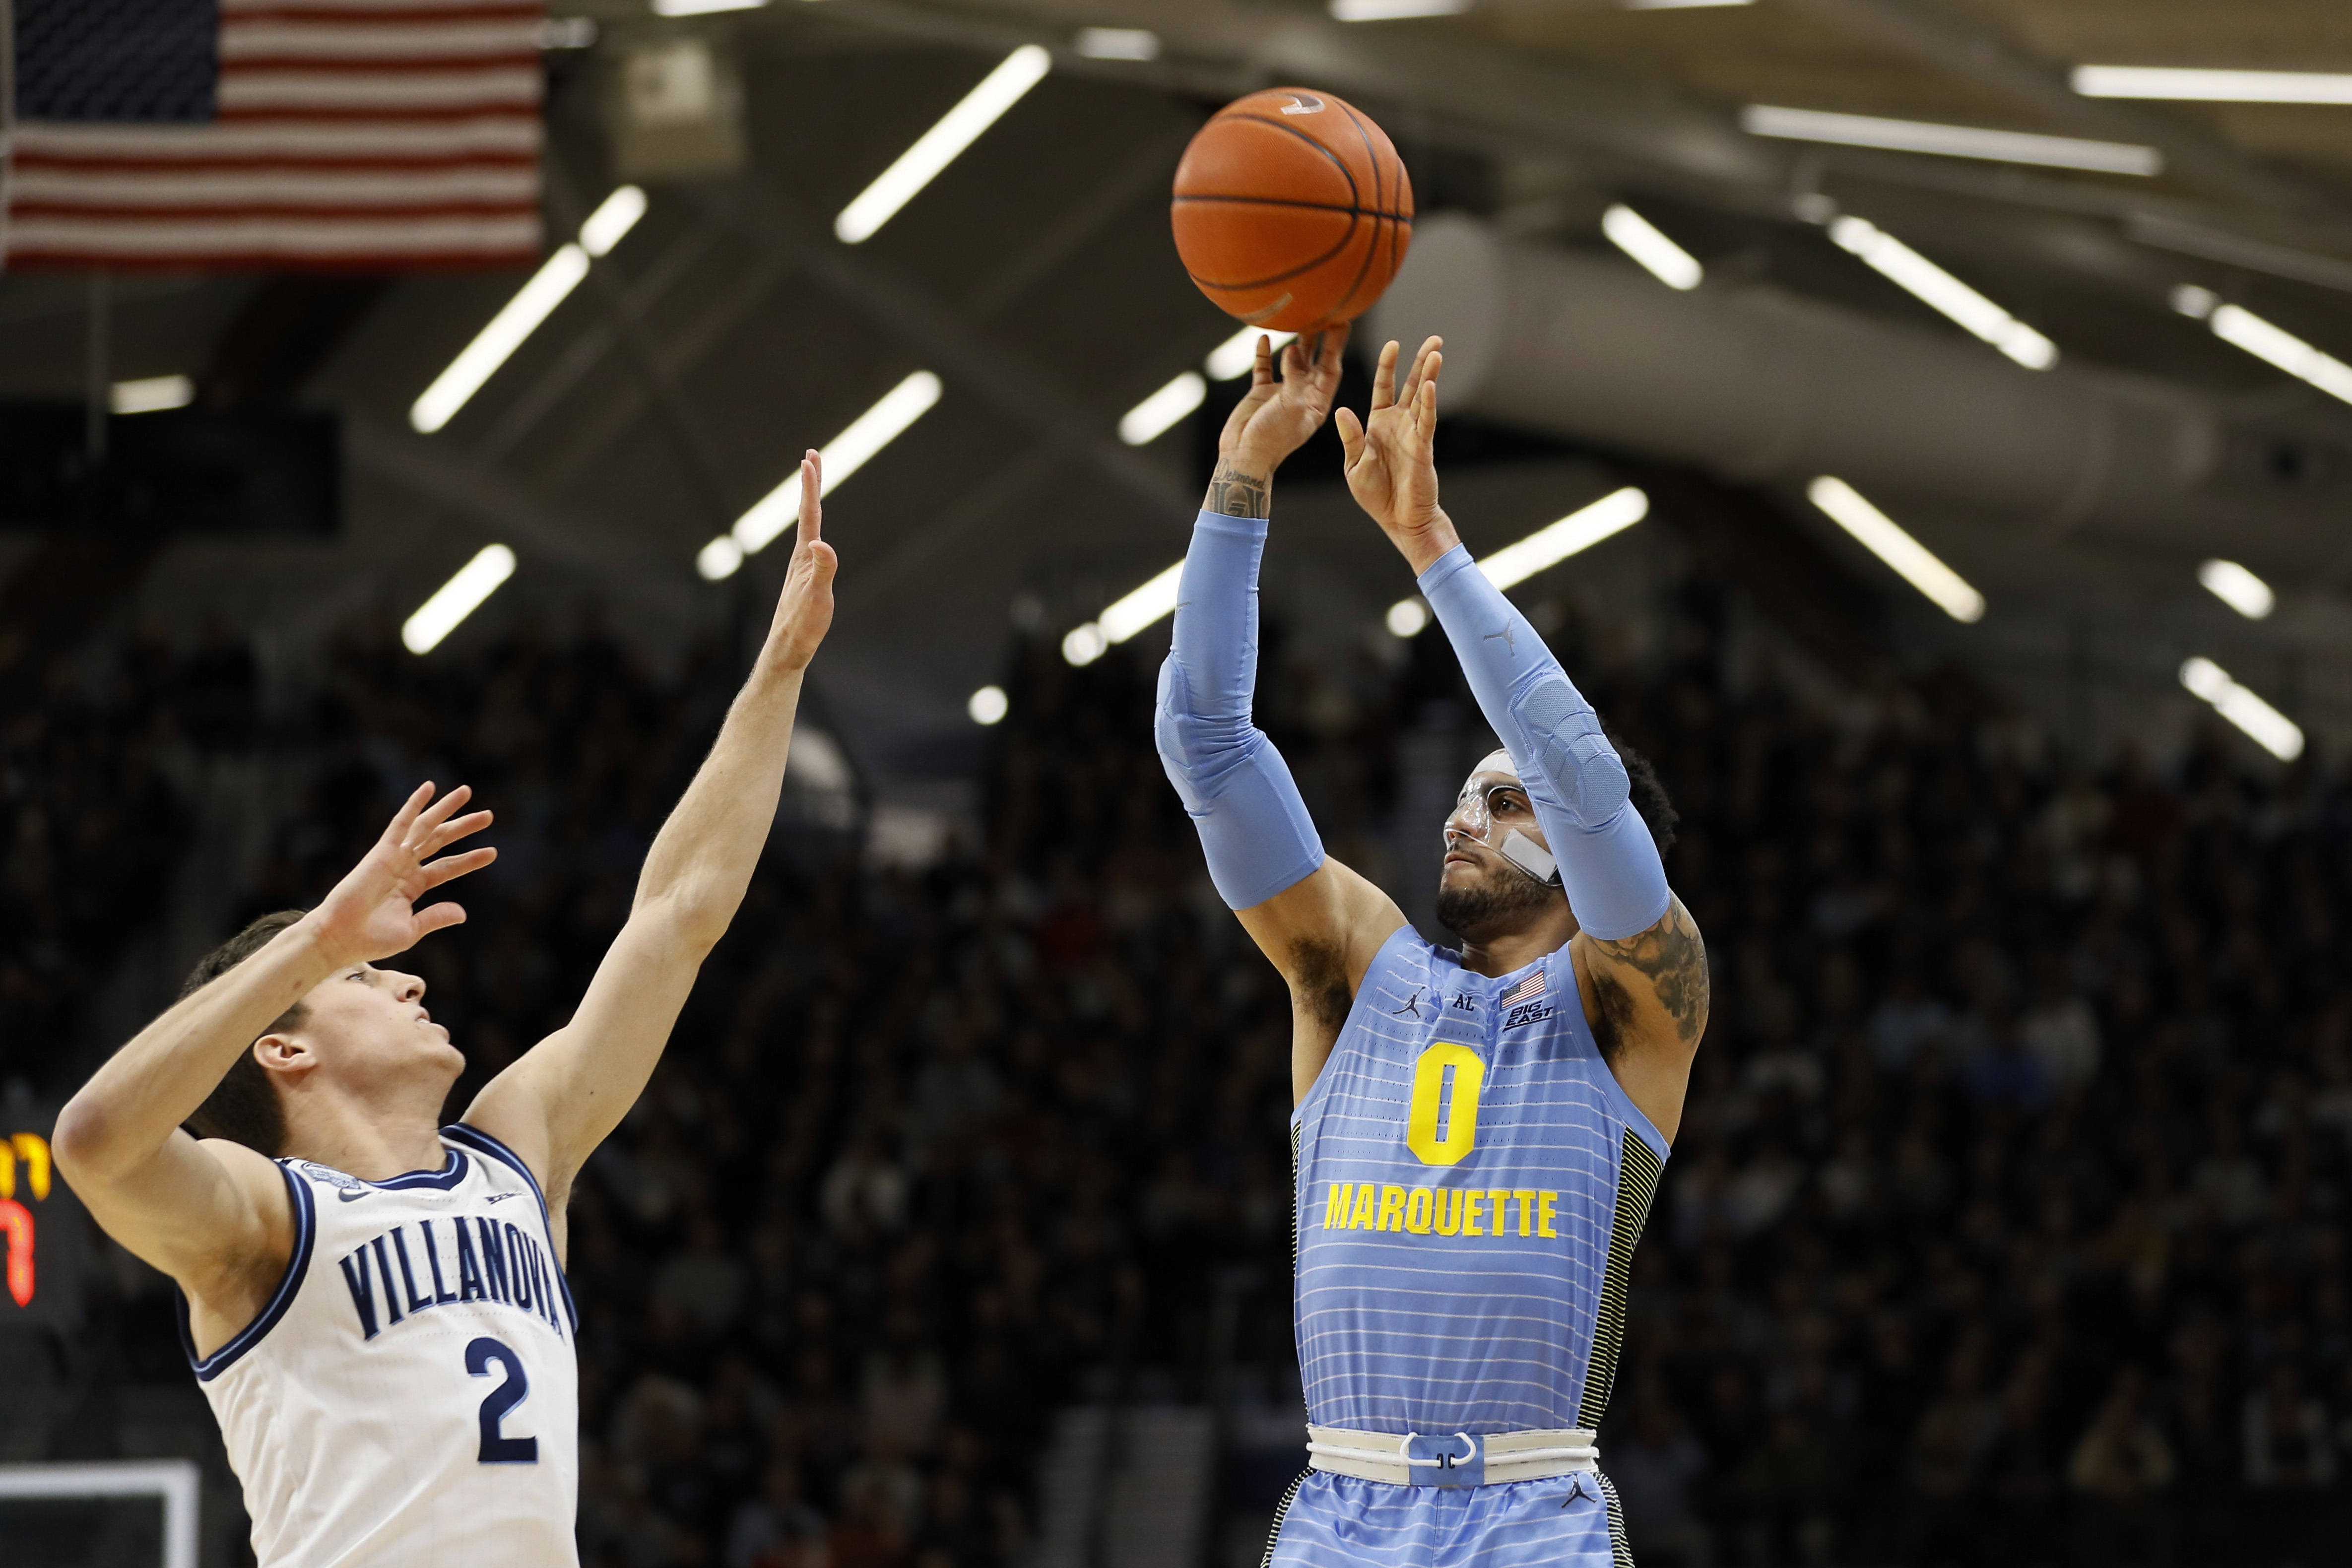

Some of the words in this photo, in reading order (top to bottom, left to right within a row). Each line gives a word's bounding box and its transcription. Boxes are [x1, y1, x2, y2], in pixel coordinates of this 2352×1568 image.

[1452, 994, 1474, 1012] AL
[1505, 1007, 1554, 1027] EAST
[1509, 1000, 1543, 1018] BIG
[1406, 1042, 1486, 1166] 0
[1323, 1183, 1558, 1239] MARQUETTE
[465, 1336, 538, 1465] 2
